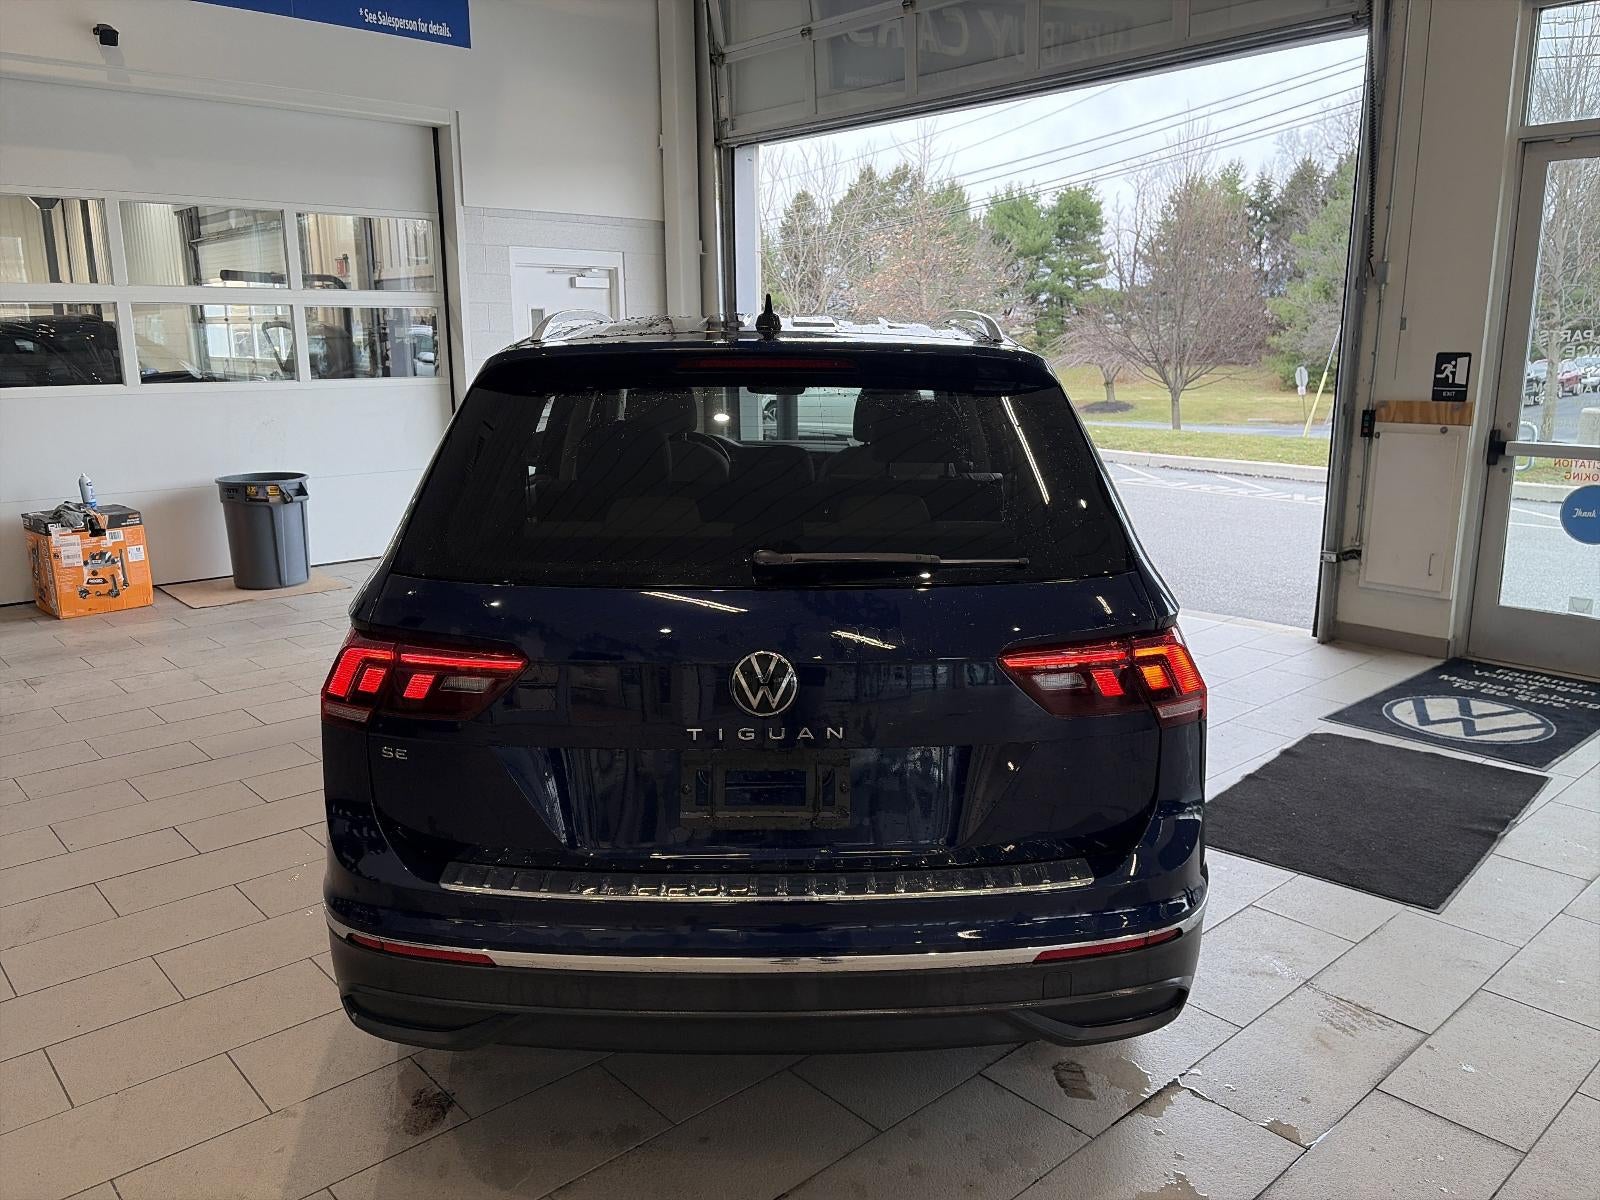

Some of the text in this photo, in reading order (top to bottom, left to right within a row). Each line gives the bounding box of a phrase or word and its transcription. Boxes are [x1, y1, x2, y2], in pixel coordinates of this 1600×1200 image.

[364, 8, 452, 38] See Salesperson for details.
[1572, 507, 1597, 519] Thank
[1474, 669, 1597, 697] Volkswagen
[686, 727, 844, 741] TIGUAN
[382, 746, 408, 760] SE
